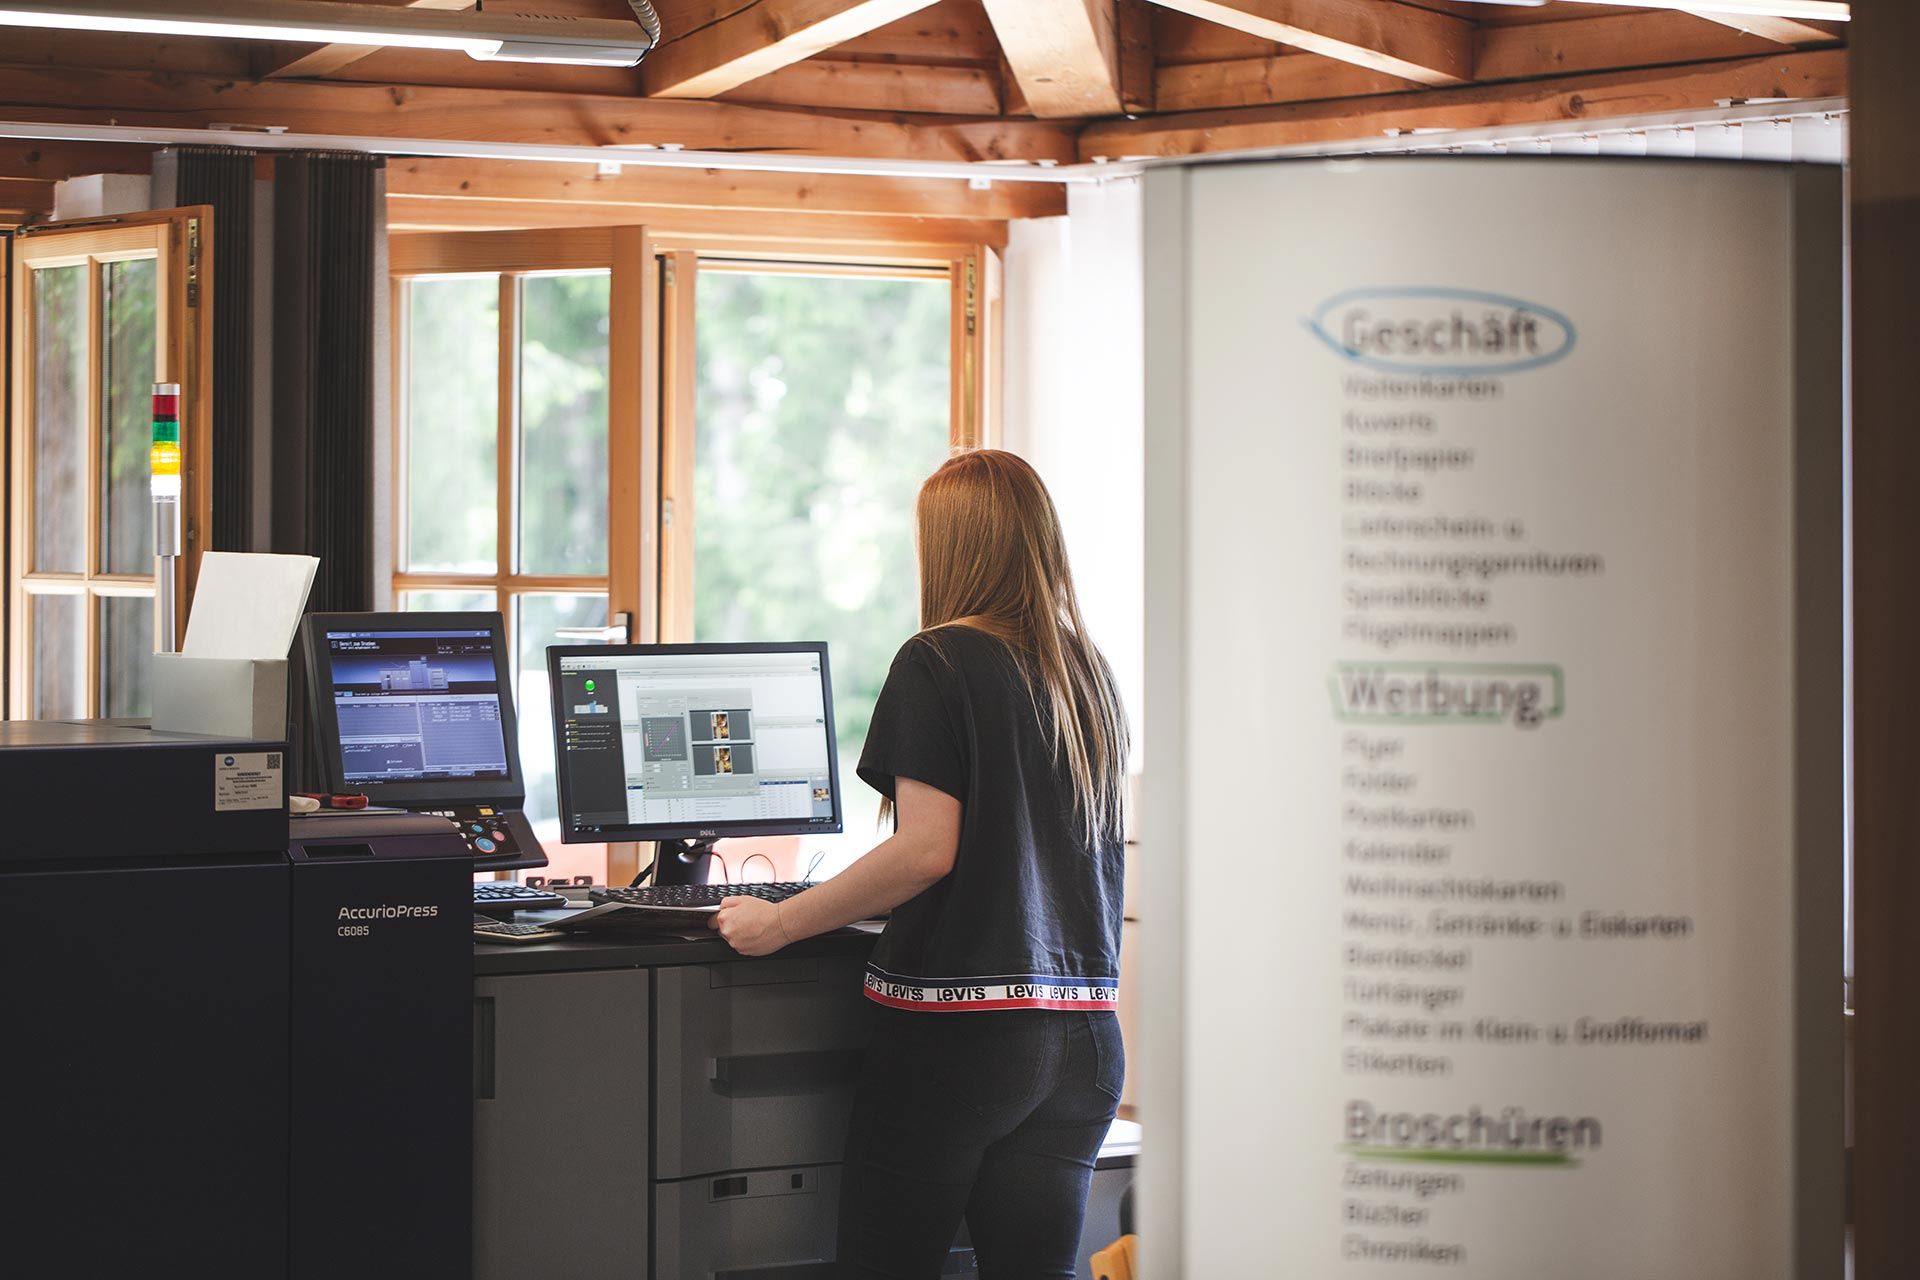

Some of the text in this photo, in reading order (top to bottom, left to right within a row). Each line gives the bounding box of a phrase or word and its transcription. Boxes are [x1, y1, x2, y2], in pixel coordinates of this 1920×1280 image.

[1344, 309, 1541, 353] Geschäft
[1344, 446, 1475, 473] Briefpapier
[1344, 480, 1423, 503] Blöcke
[1344, 586, 1491, 611] Spiralblöcke
[1343, 668, 1543, 728] Werbung
[1344, 734, 1404, 764] Flyer
[1345, 805, 1475, 830] Postkarten
[1345, 840, 1452, 864] Kalender
[1345, 875, 1565, 902] Weihnachtskarten
[338, 904, 438, 920] AccurioPress
[337, 925, 369, 936] C6085
[1345, 945, 1471, 970] Bierdeckel
[1344, 1100, 1602, 1150] Broschüren
[1344, 1167, 1463, 1198] Zeitungen
[1344, 1202, 1428, 1226] Bücher
